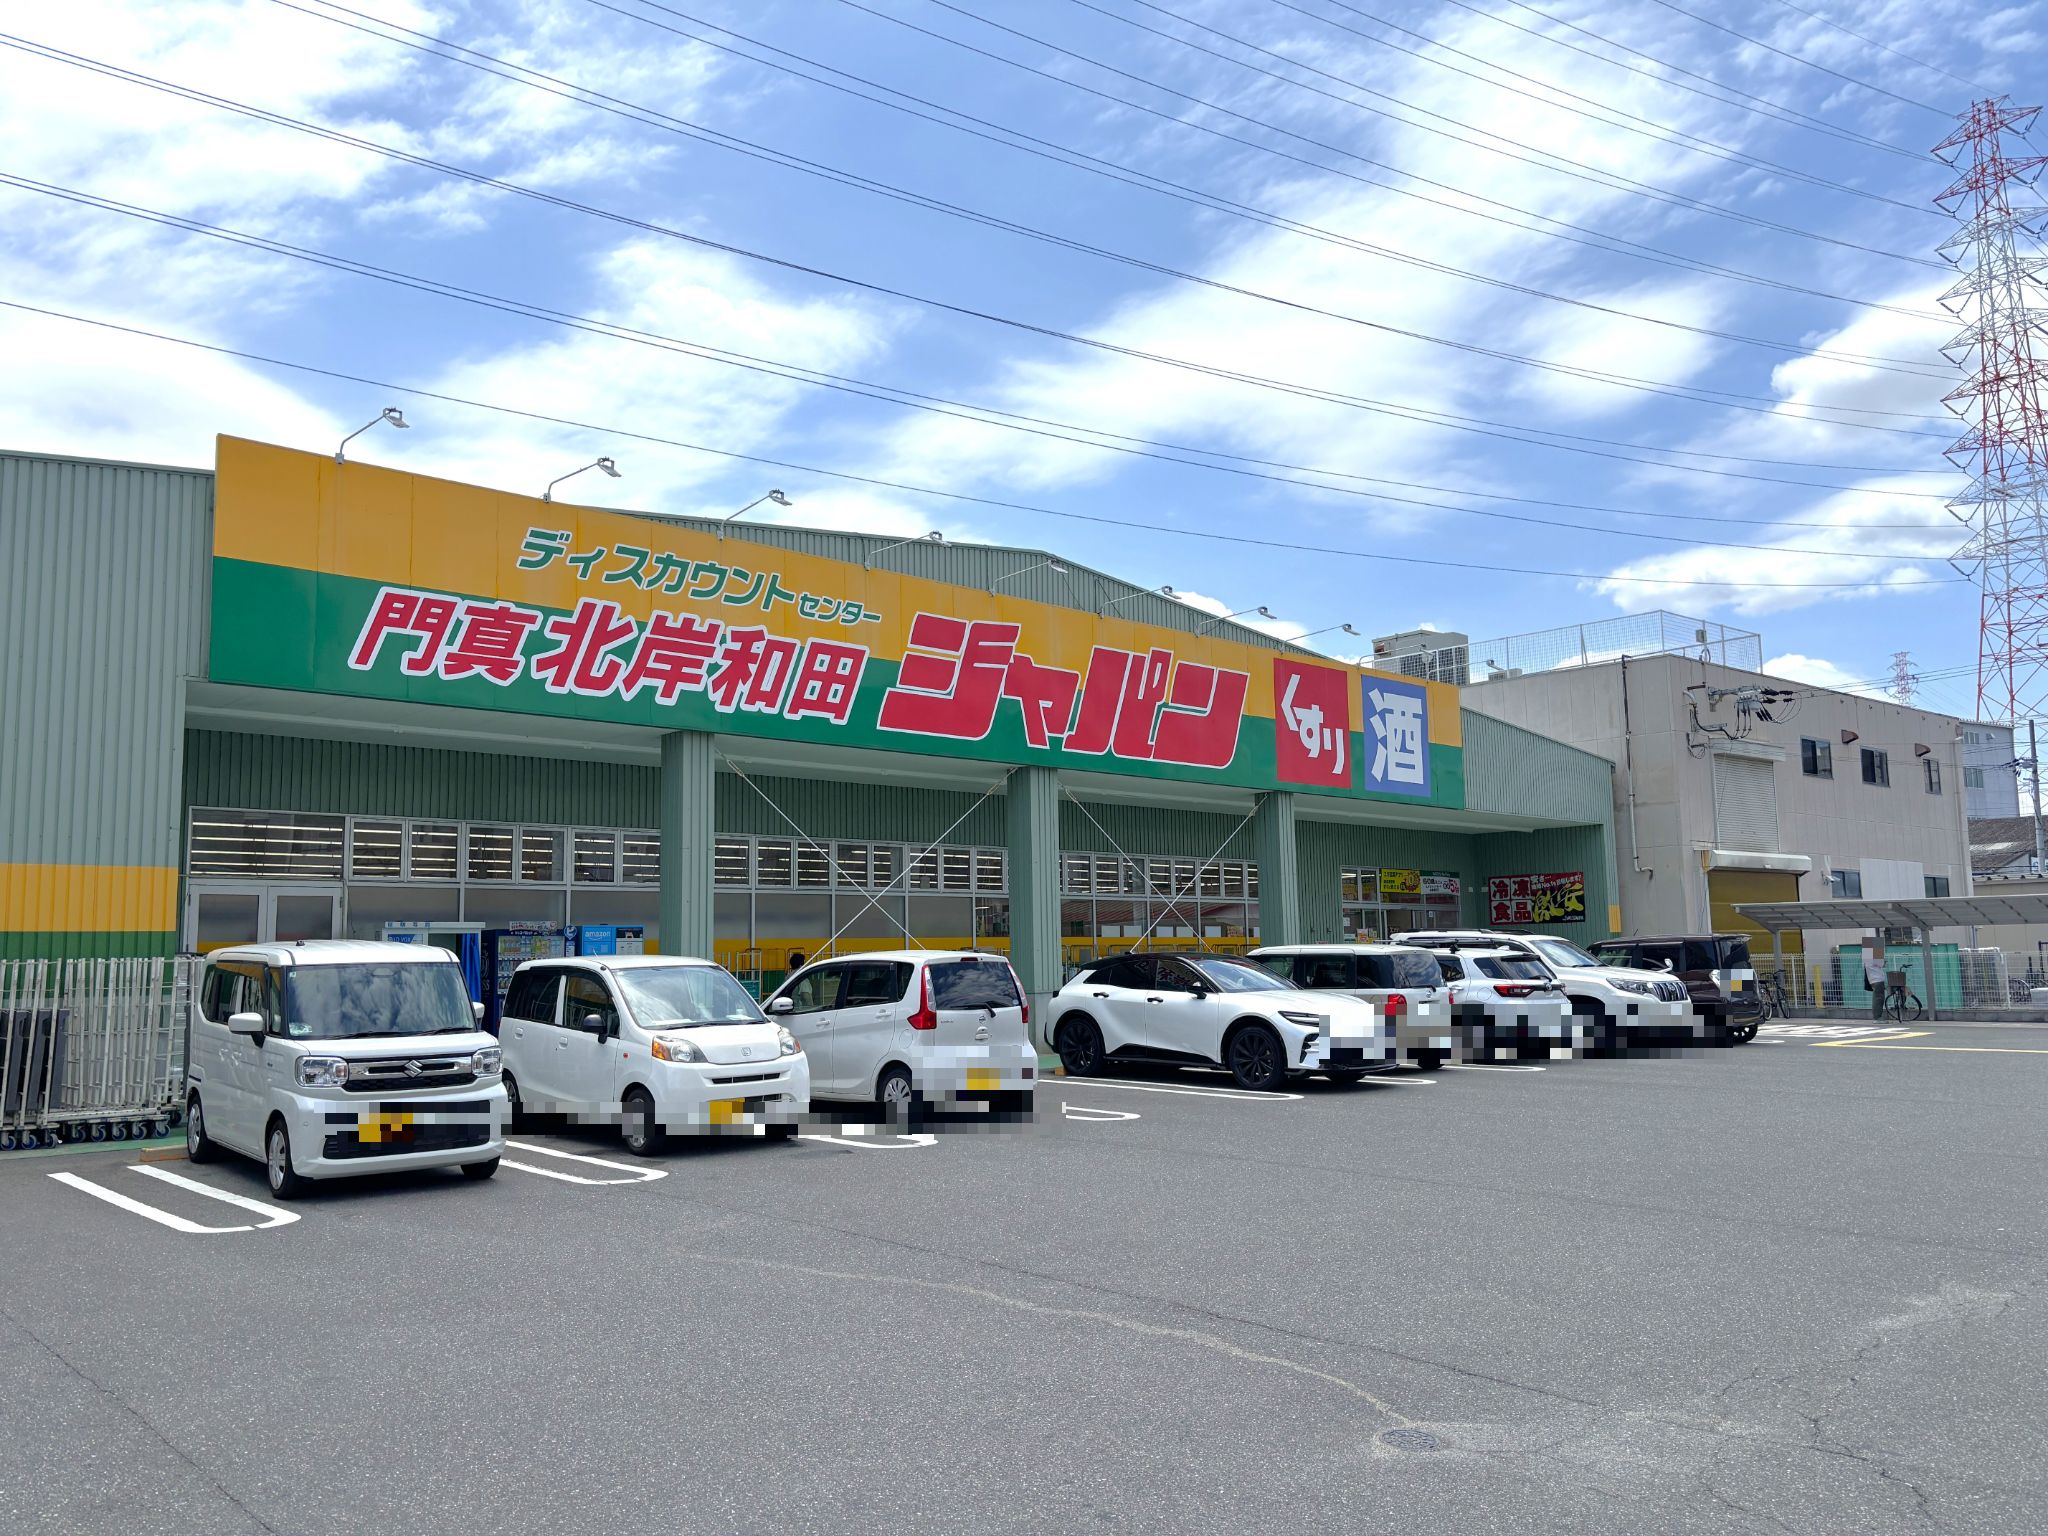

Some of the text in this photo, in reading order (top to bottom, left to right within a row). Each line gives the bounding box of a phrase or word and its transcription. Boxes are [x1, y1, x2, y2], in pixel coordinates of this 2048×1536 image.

[516, 526, 882, 625] ディスカウントセンター
[347, 586, 870, 726] 門真北岸和田
[877, 612, 1250, 769] ジャパン
[1281, 674, 1346, 776] くすり
[1367, 687, 1425, 785] 酒
[585, 930, 611, 938] amazon
[1491, 879, 1530, 899] 冷凍
[1493, 901, 1532, 921] 食品
[1533, 882, 1585, 923] 激安
